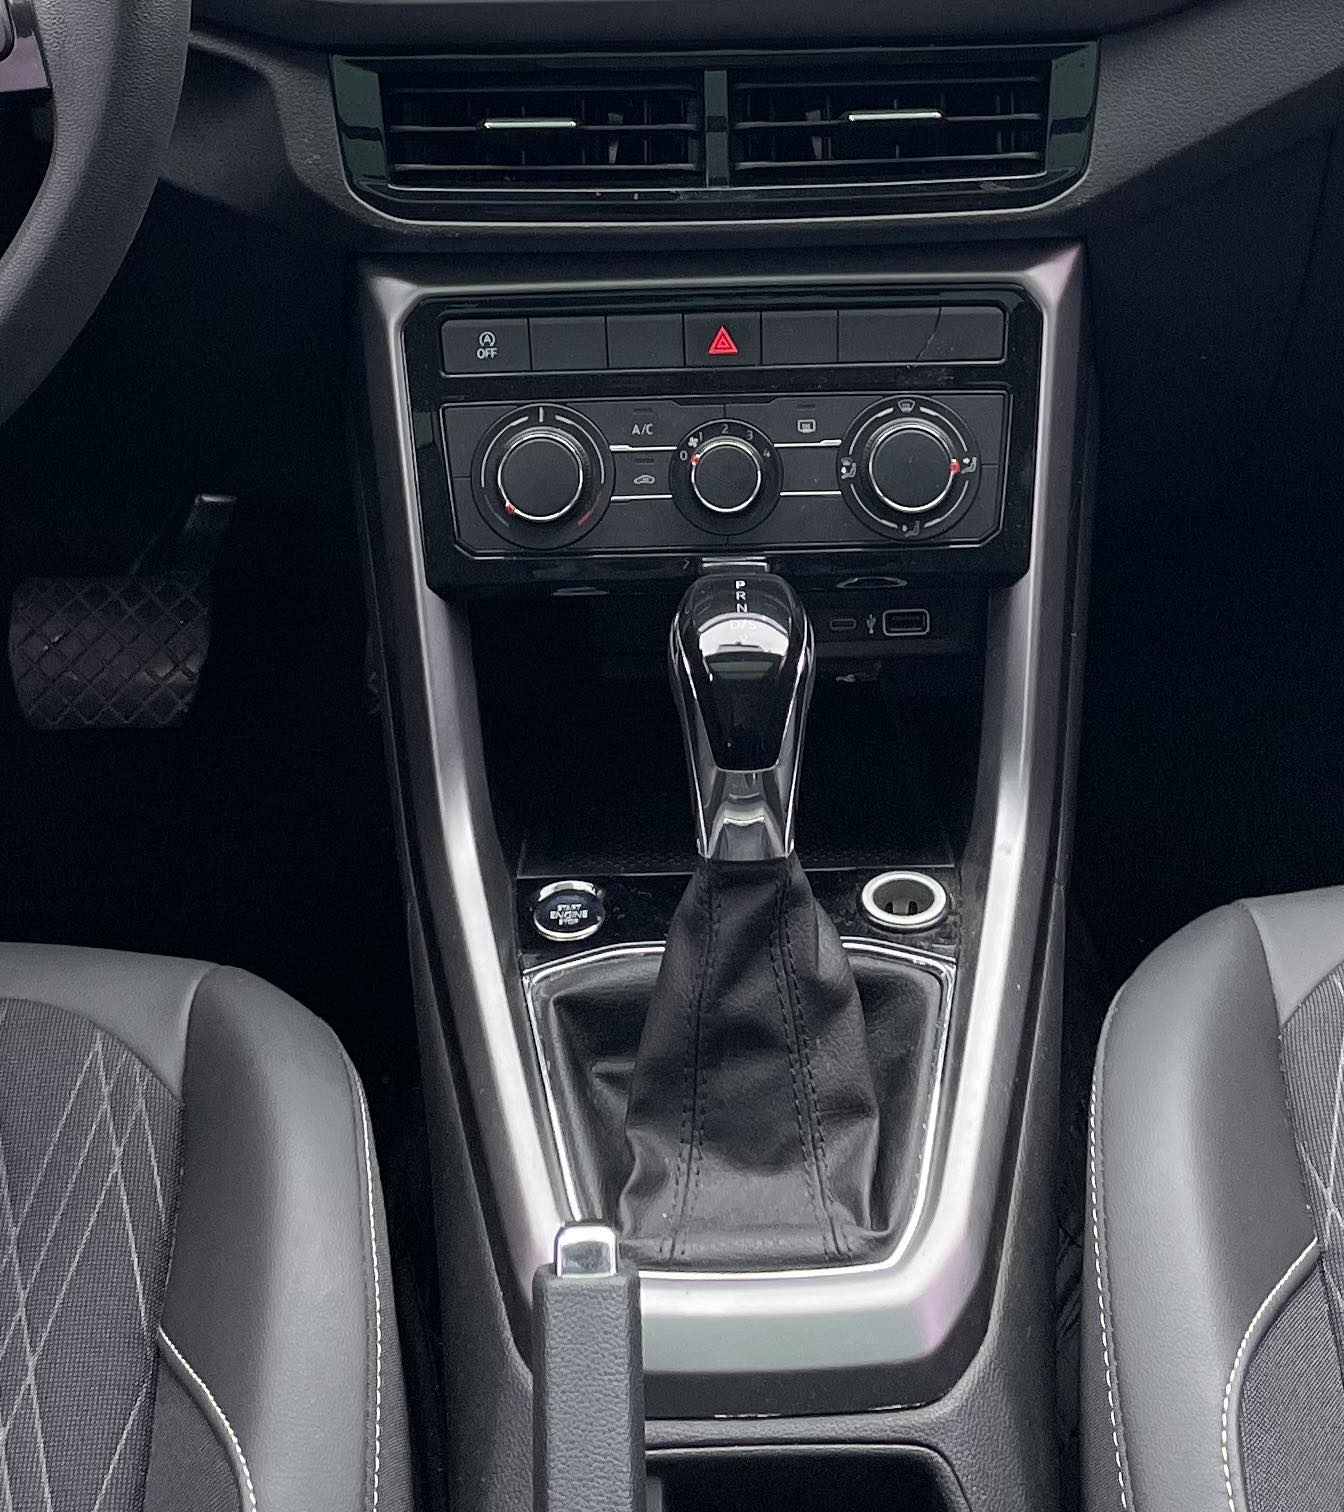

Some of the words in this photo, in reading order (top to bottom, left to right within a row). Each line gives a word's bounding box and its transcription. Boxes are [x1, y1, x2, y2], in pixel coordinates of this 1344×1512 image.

[476, 347, 498, 359] OFF
[631, 422, 654, 436] A/C
[721, 424, 729, 433] 2
[746, 430, 754, 440] 3
[763, 448, 770, 458] 4
[735, 580, 745, 589] P
[736, 591, 746, 600] R
[737, 603, 747, 613] N
[549, 910, 589, 919] ENGINE
